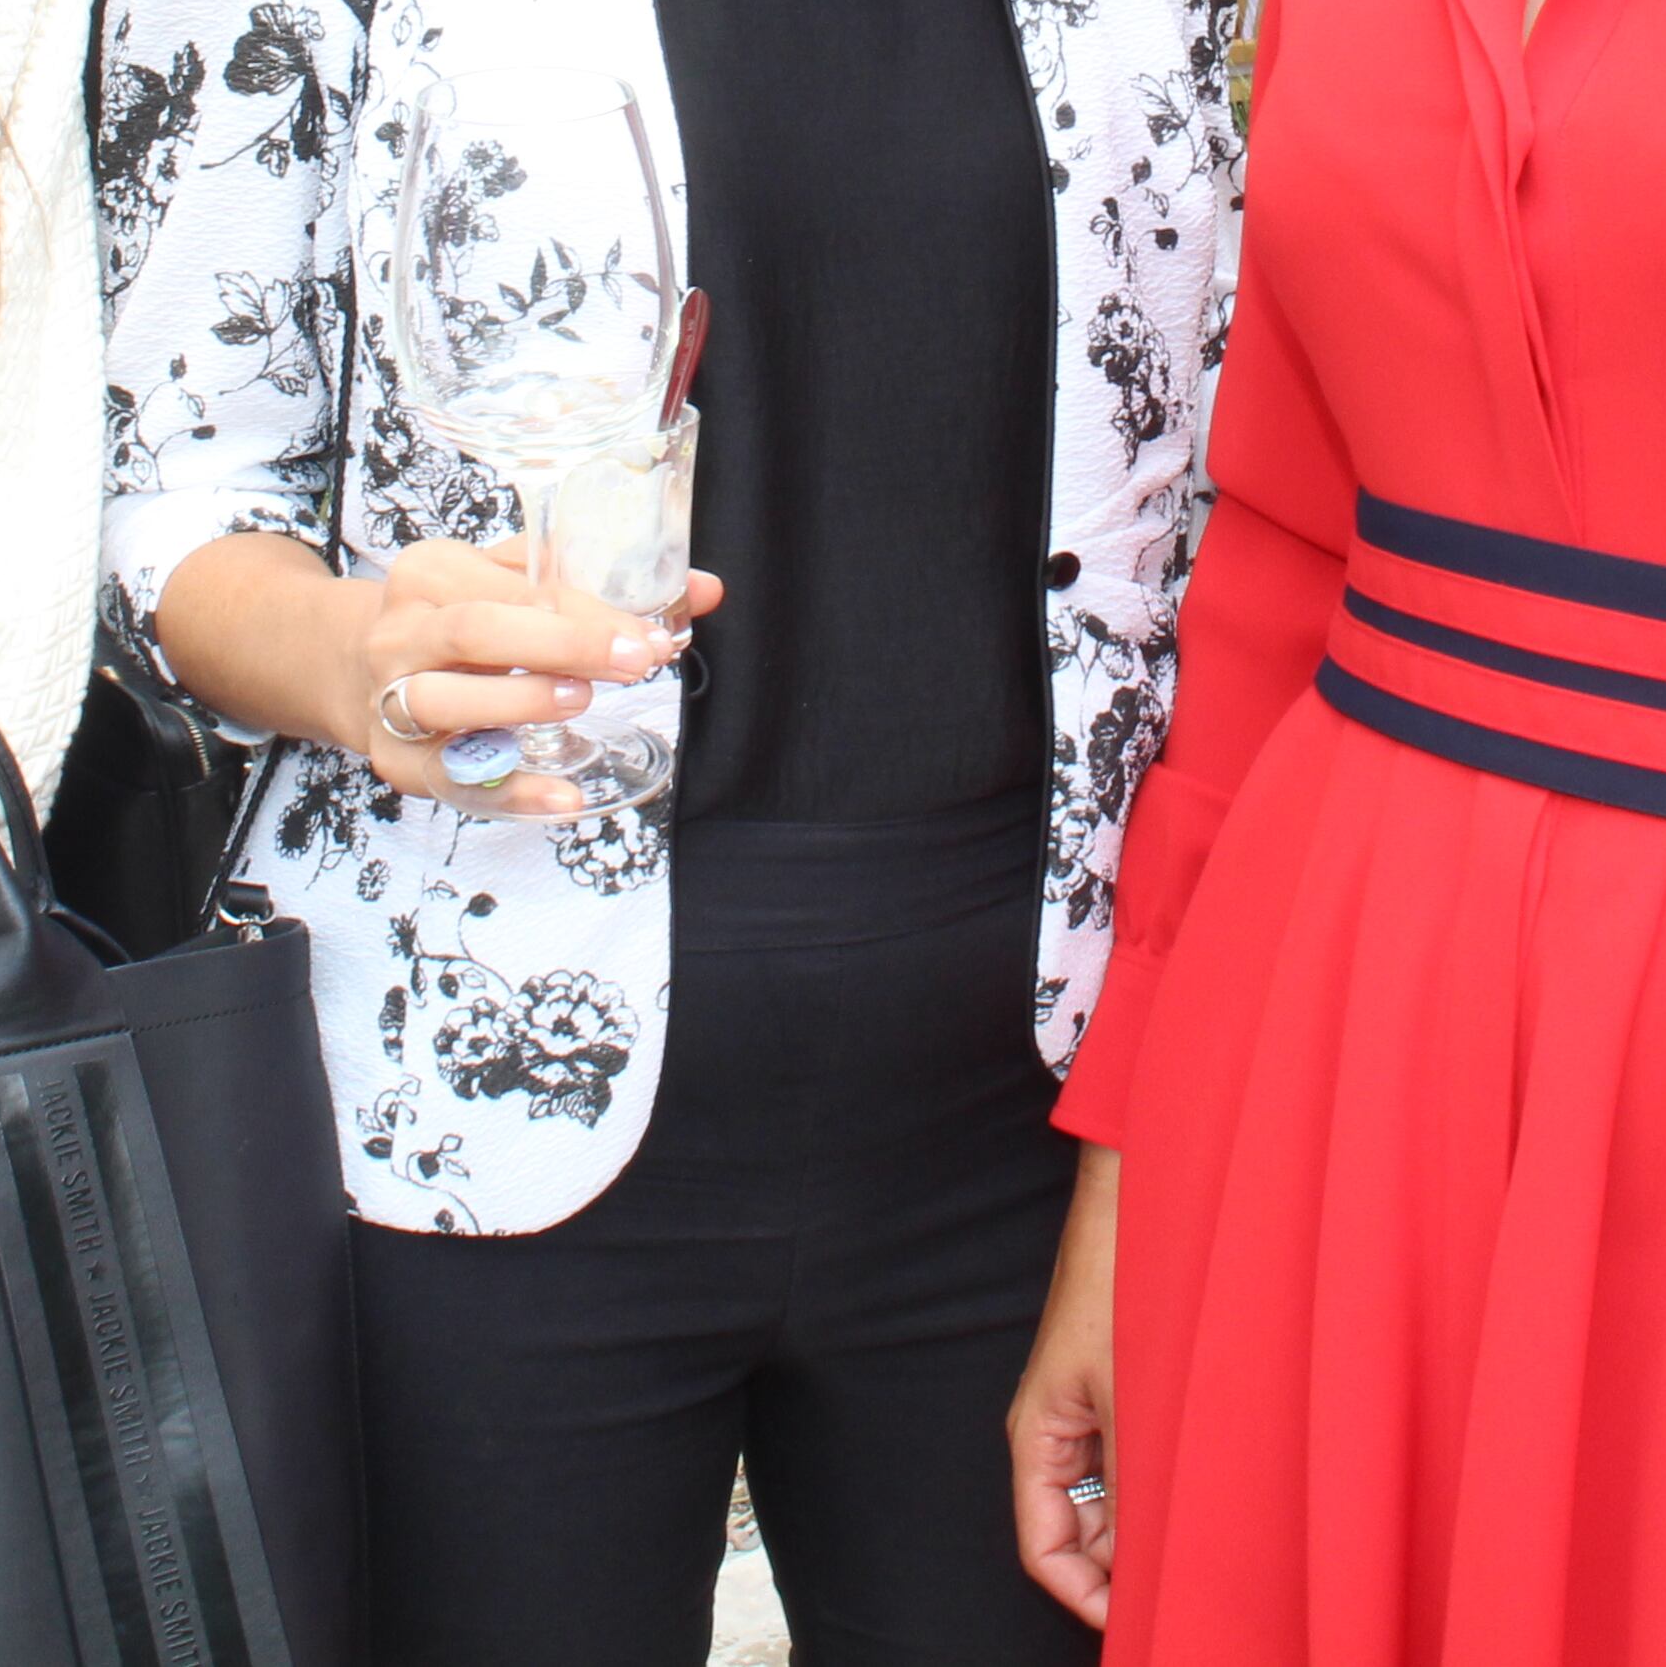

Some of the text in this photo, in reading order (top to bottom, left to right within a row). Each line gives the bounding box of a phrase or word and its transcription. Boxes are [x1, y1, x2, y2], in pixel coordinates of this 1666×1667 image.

[37, 1079, 83, 1167] JACKIE
[61, 1170, 105, 1254] SMITH
[89, 1291, 131, 1381] JACKIE
[109, 1384, 153, 1467] SMITH
[139, 1506, 183, 1598] JACKIE
